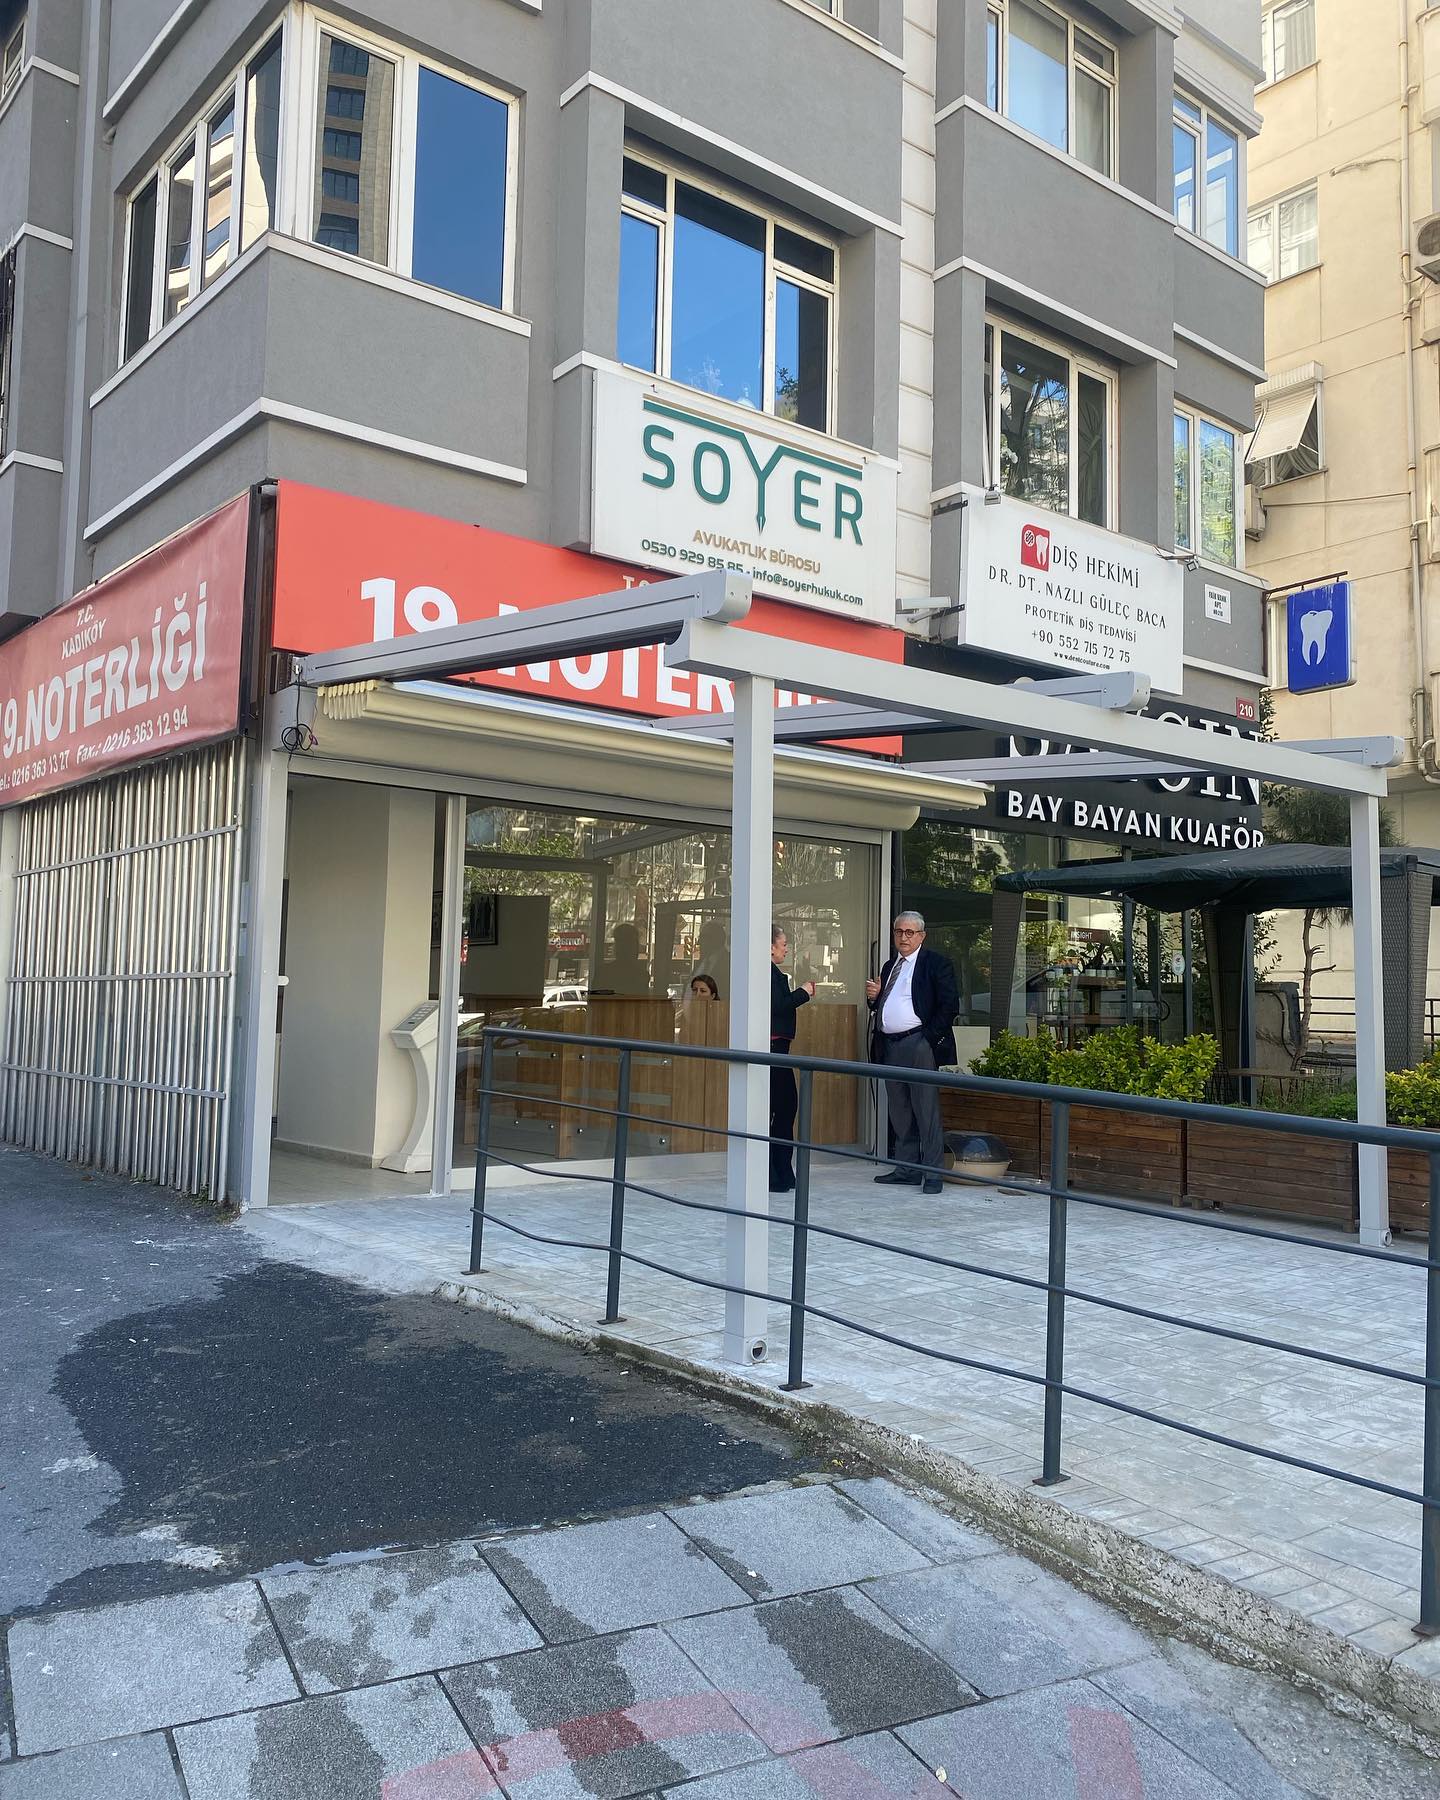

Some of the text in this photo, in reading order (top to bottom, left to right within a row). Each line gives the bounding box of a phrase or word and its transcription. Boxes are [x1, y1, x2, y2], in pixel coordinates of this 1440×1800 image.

[641, 400, 864, 545] SOYER
[641, 538, 677, 557] 0530
[679, 549, 705, 565] 929
[708, 556, 724, 569] 85
[752, 567, 864, 606] info@soyerhukuk.com
[692, 530, 821, 574] AVUKATLIK BÜROSU
[1053, 546, 1140, 588] DİŞ HEKİMİ
[76, 604, 95, 627] T.C.
[989, 565, 1167, 630] DR. DT. NAZLI GÜLEÇ BACA
[61, 618, 107, 660] KADIKÖY
[1025, 604, 1137, 643] PROTETİK DİŞ TEDAVİSİ
[1031, 629, 1131, 664] +90 552 715 72 75
[0, 581, 208, 759] 9.NOTERLİĞİ
[1239, 703, 1254, 718] 210
[11, 765, 31, 787] 0216
[31, 758, 47, 780] 363
[49, 753, 59, 774] 13
[59, 749, 70, 771] 27
[76, 742, 103, 765] Fax.:
[102, 728, 131, 754] 0216
[132, 719, 154, 745] 363
[157, 712, 171, 737] 12
[173, 704, 188, 732] 94
[1008, 789, 1264, 850] BAY BAYAN KUAFÖR
